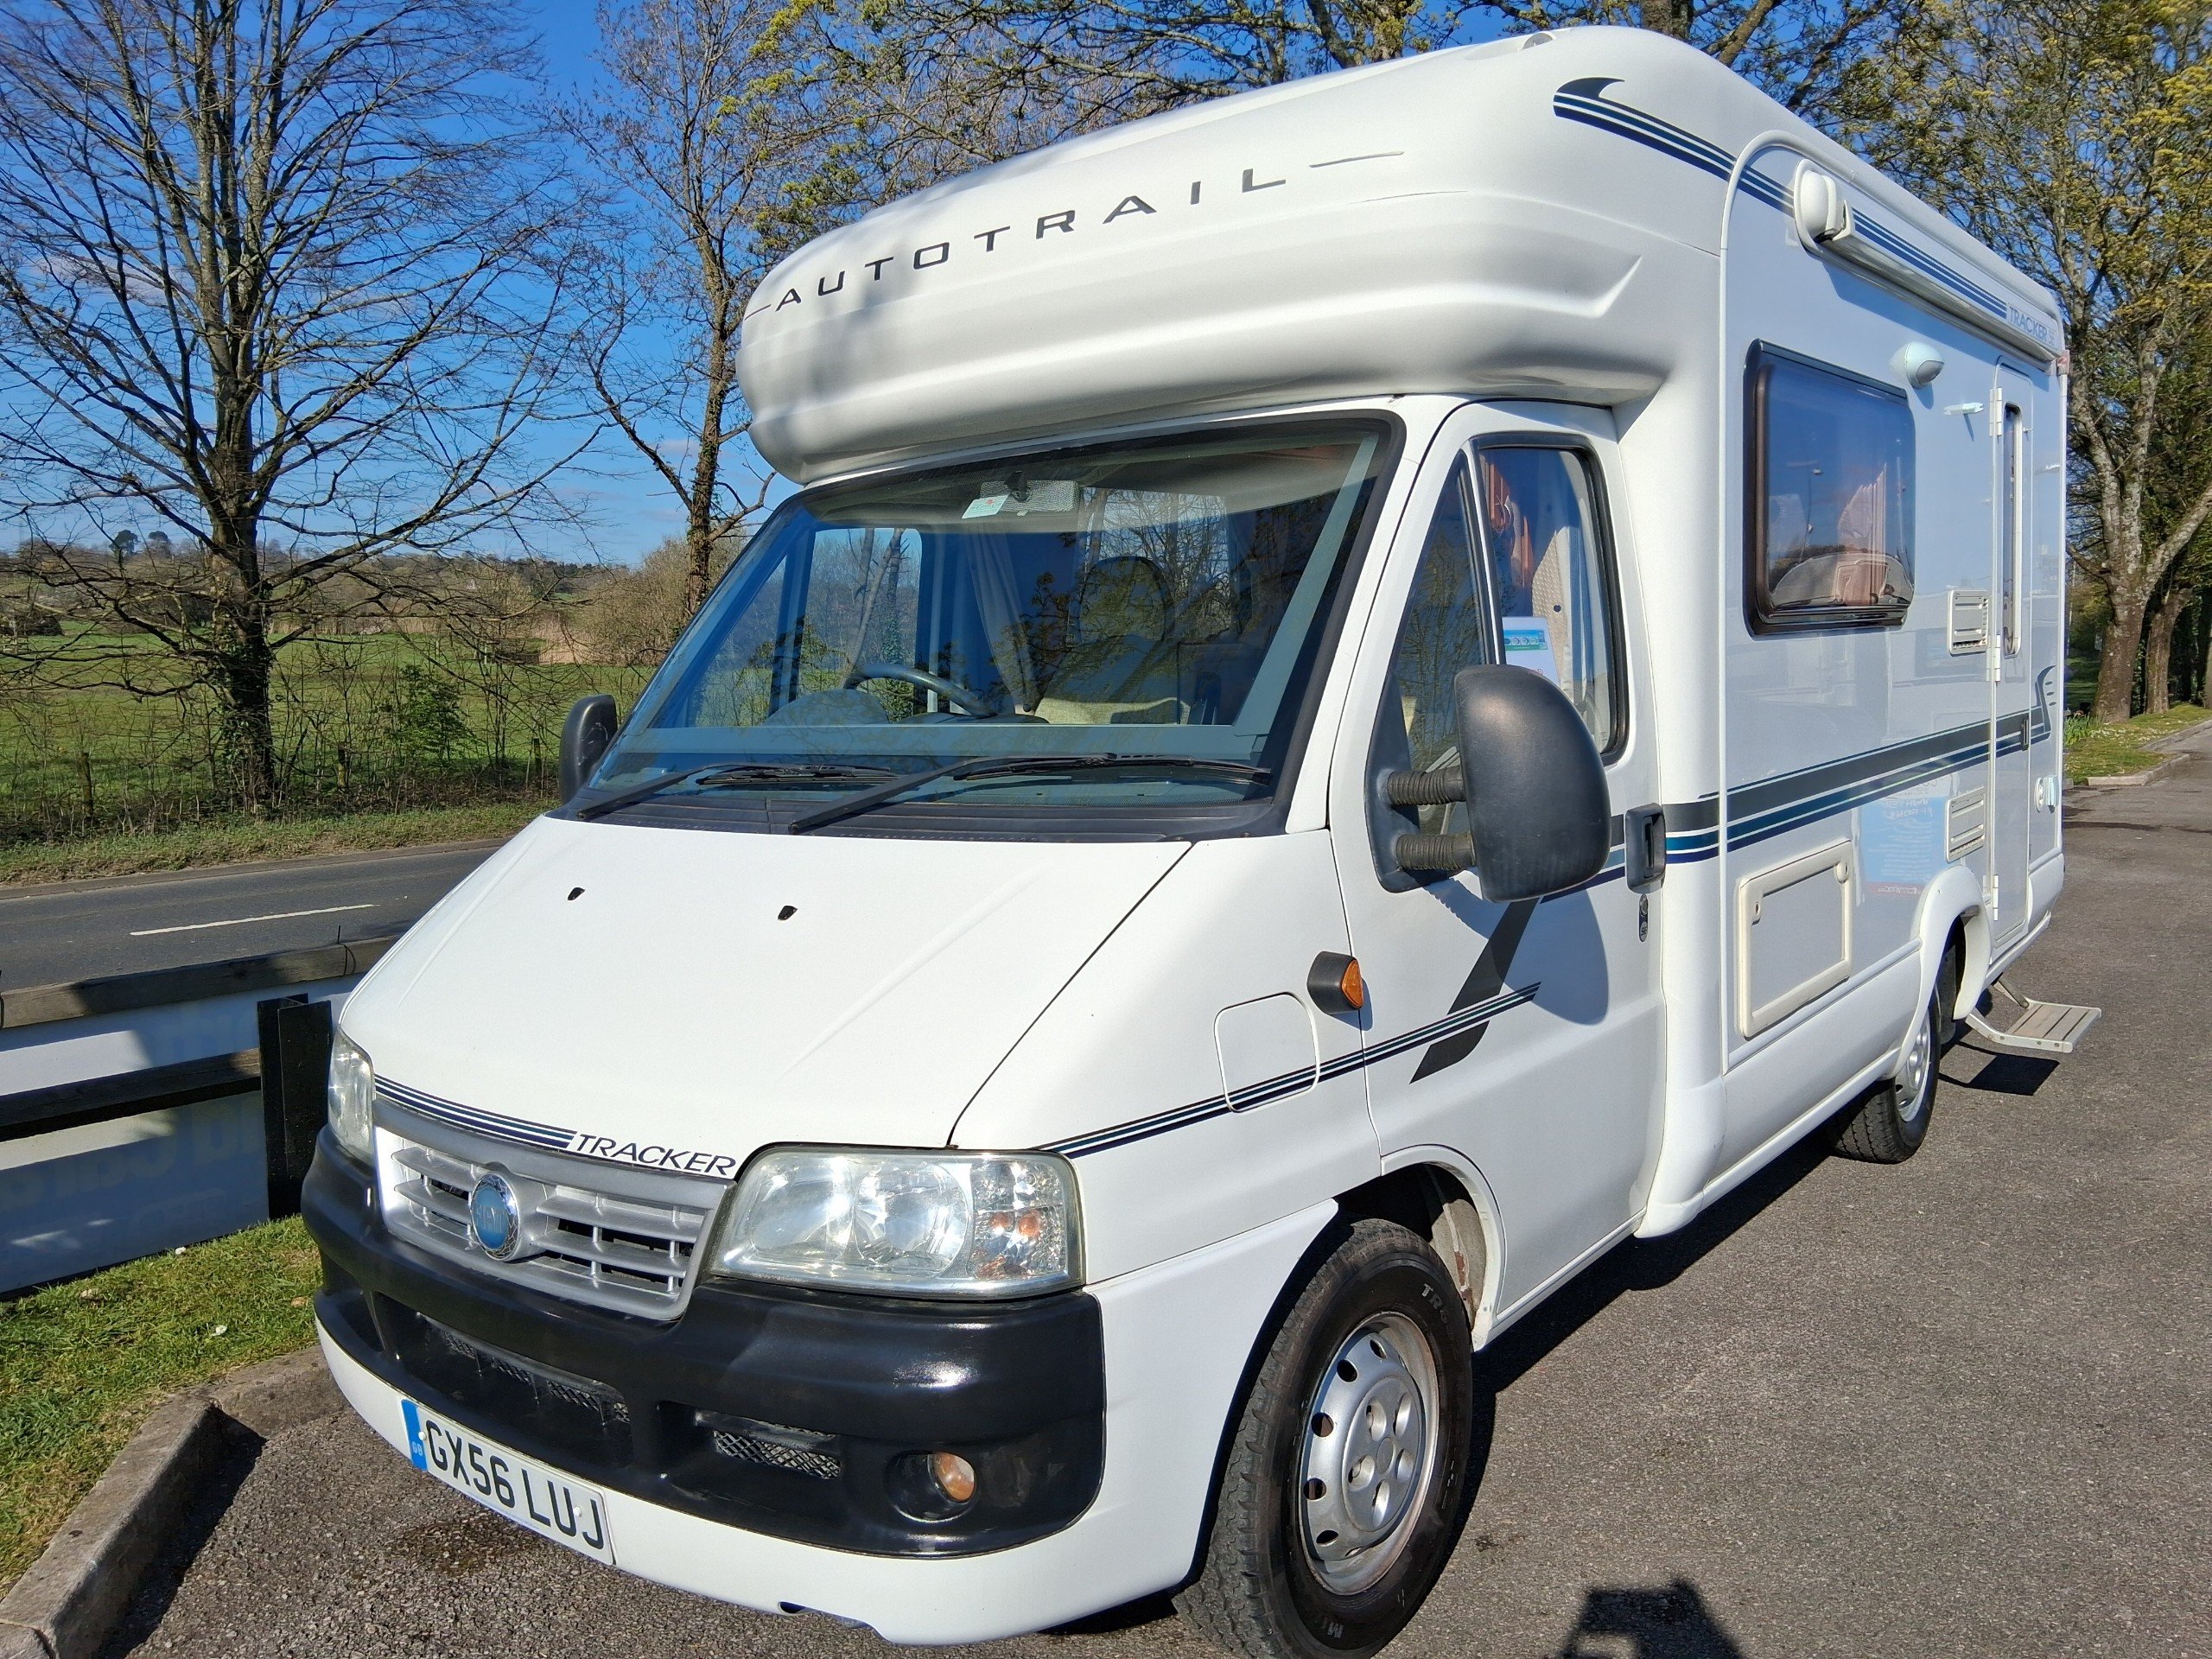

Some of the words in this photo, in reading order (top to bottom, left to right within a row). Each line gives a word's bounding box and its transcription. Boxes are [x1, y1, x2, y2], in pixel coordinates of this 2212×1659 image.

[774, 168, 1287, 312] AUTOTRAIL
[2009, 306, 2048, 341] TRACKER
[576, 1134, 737, 1176] TRACKER
[411, 1440, 423, 1457] GB
[425, 1420, 516, 1509] GX56
[520, 1468, 605, 1550] LUJ
